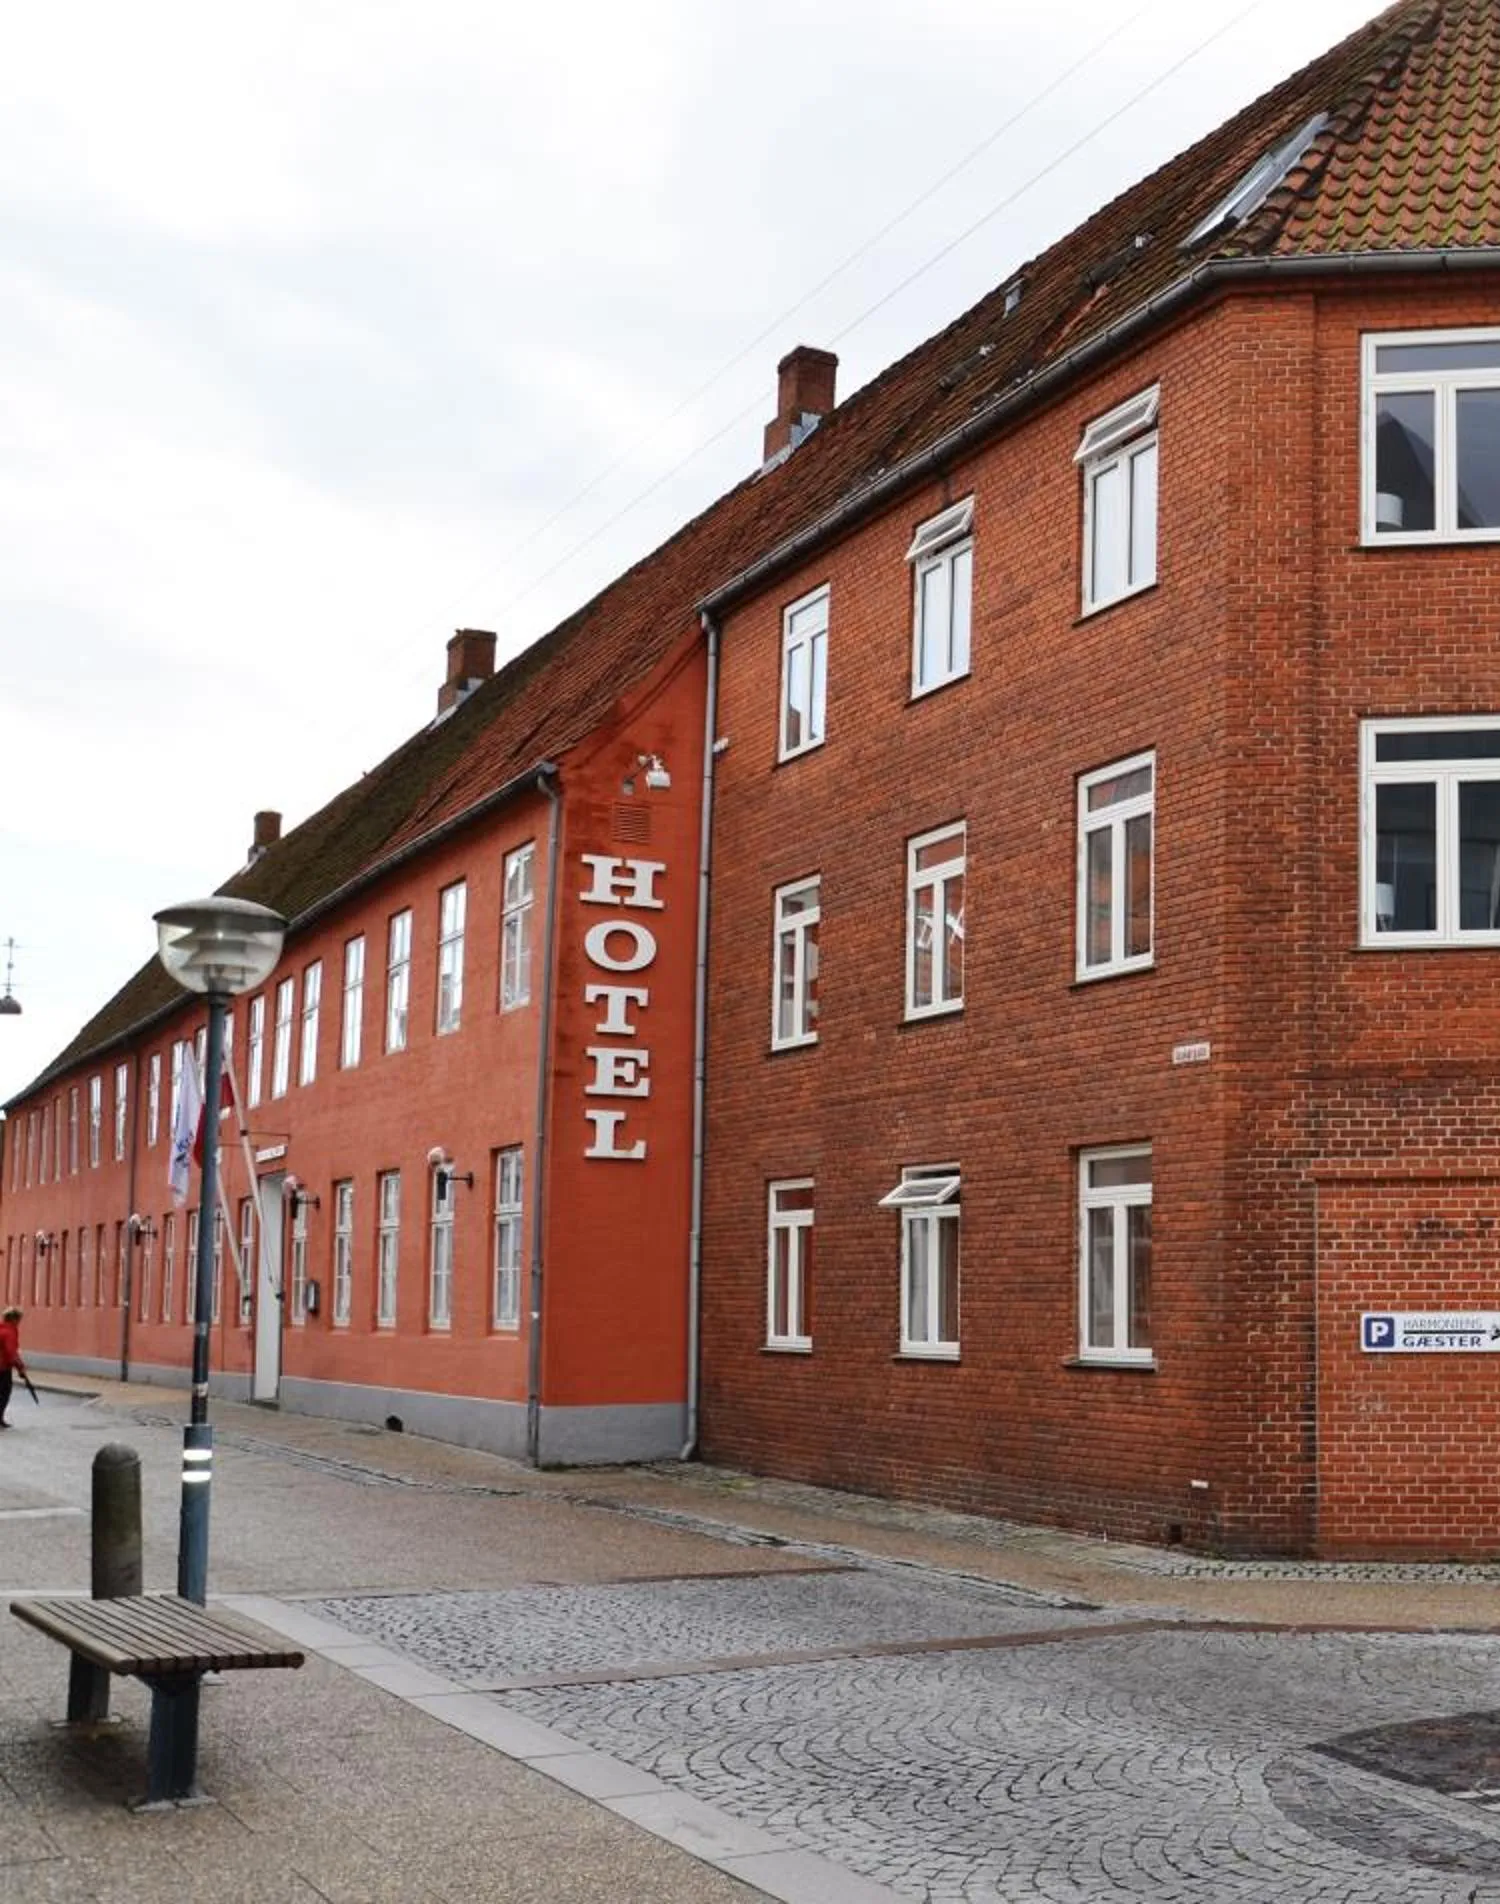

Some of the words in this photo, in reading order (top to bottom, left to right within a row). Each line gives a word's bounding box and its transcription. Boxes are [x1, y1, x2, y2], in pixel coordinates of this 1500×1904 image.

[579, 854, 666, 1160] HOTEL
[1371, 1321, 1389, 1344] P
[1402, 1335, 1482, 1347] GÆSTER
